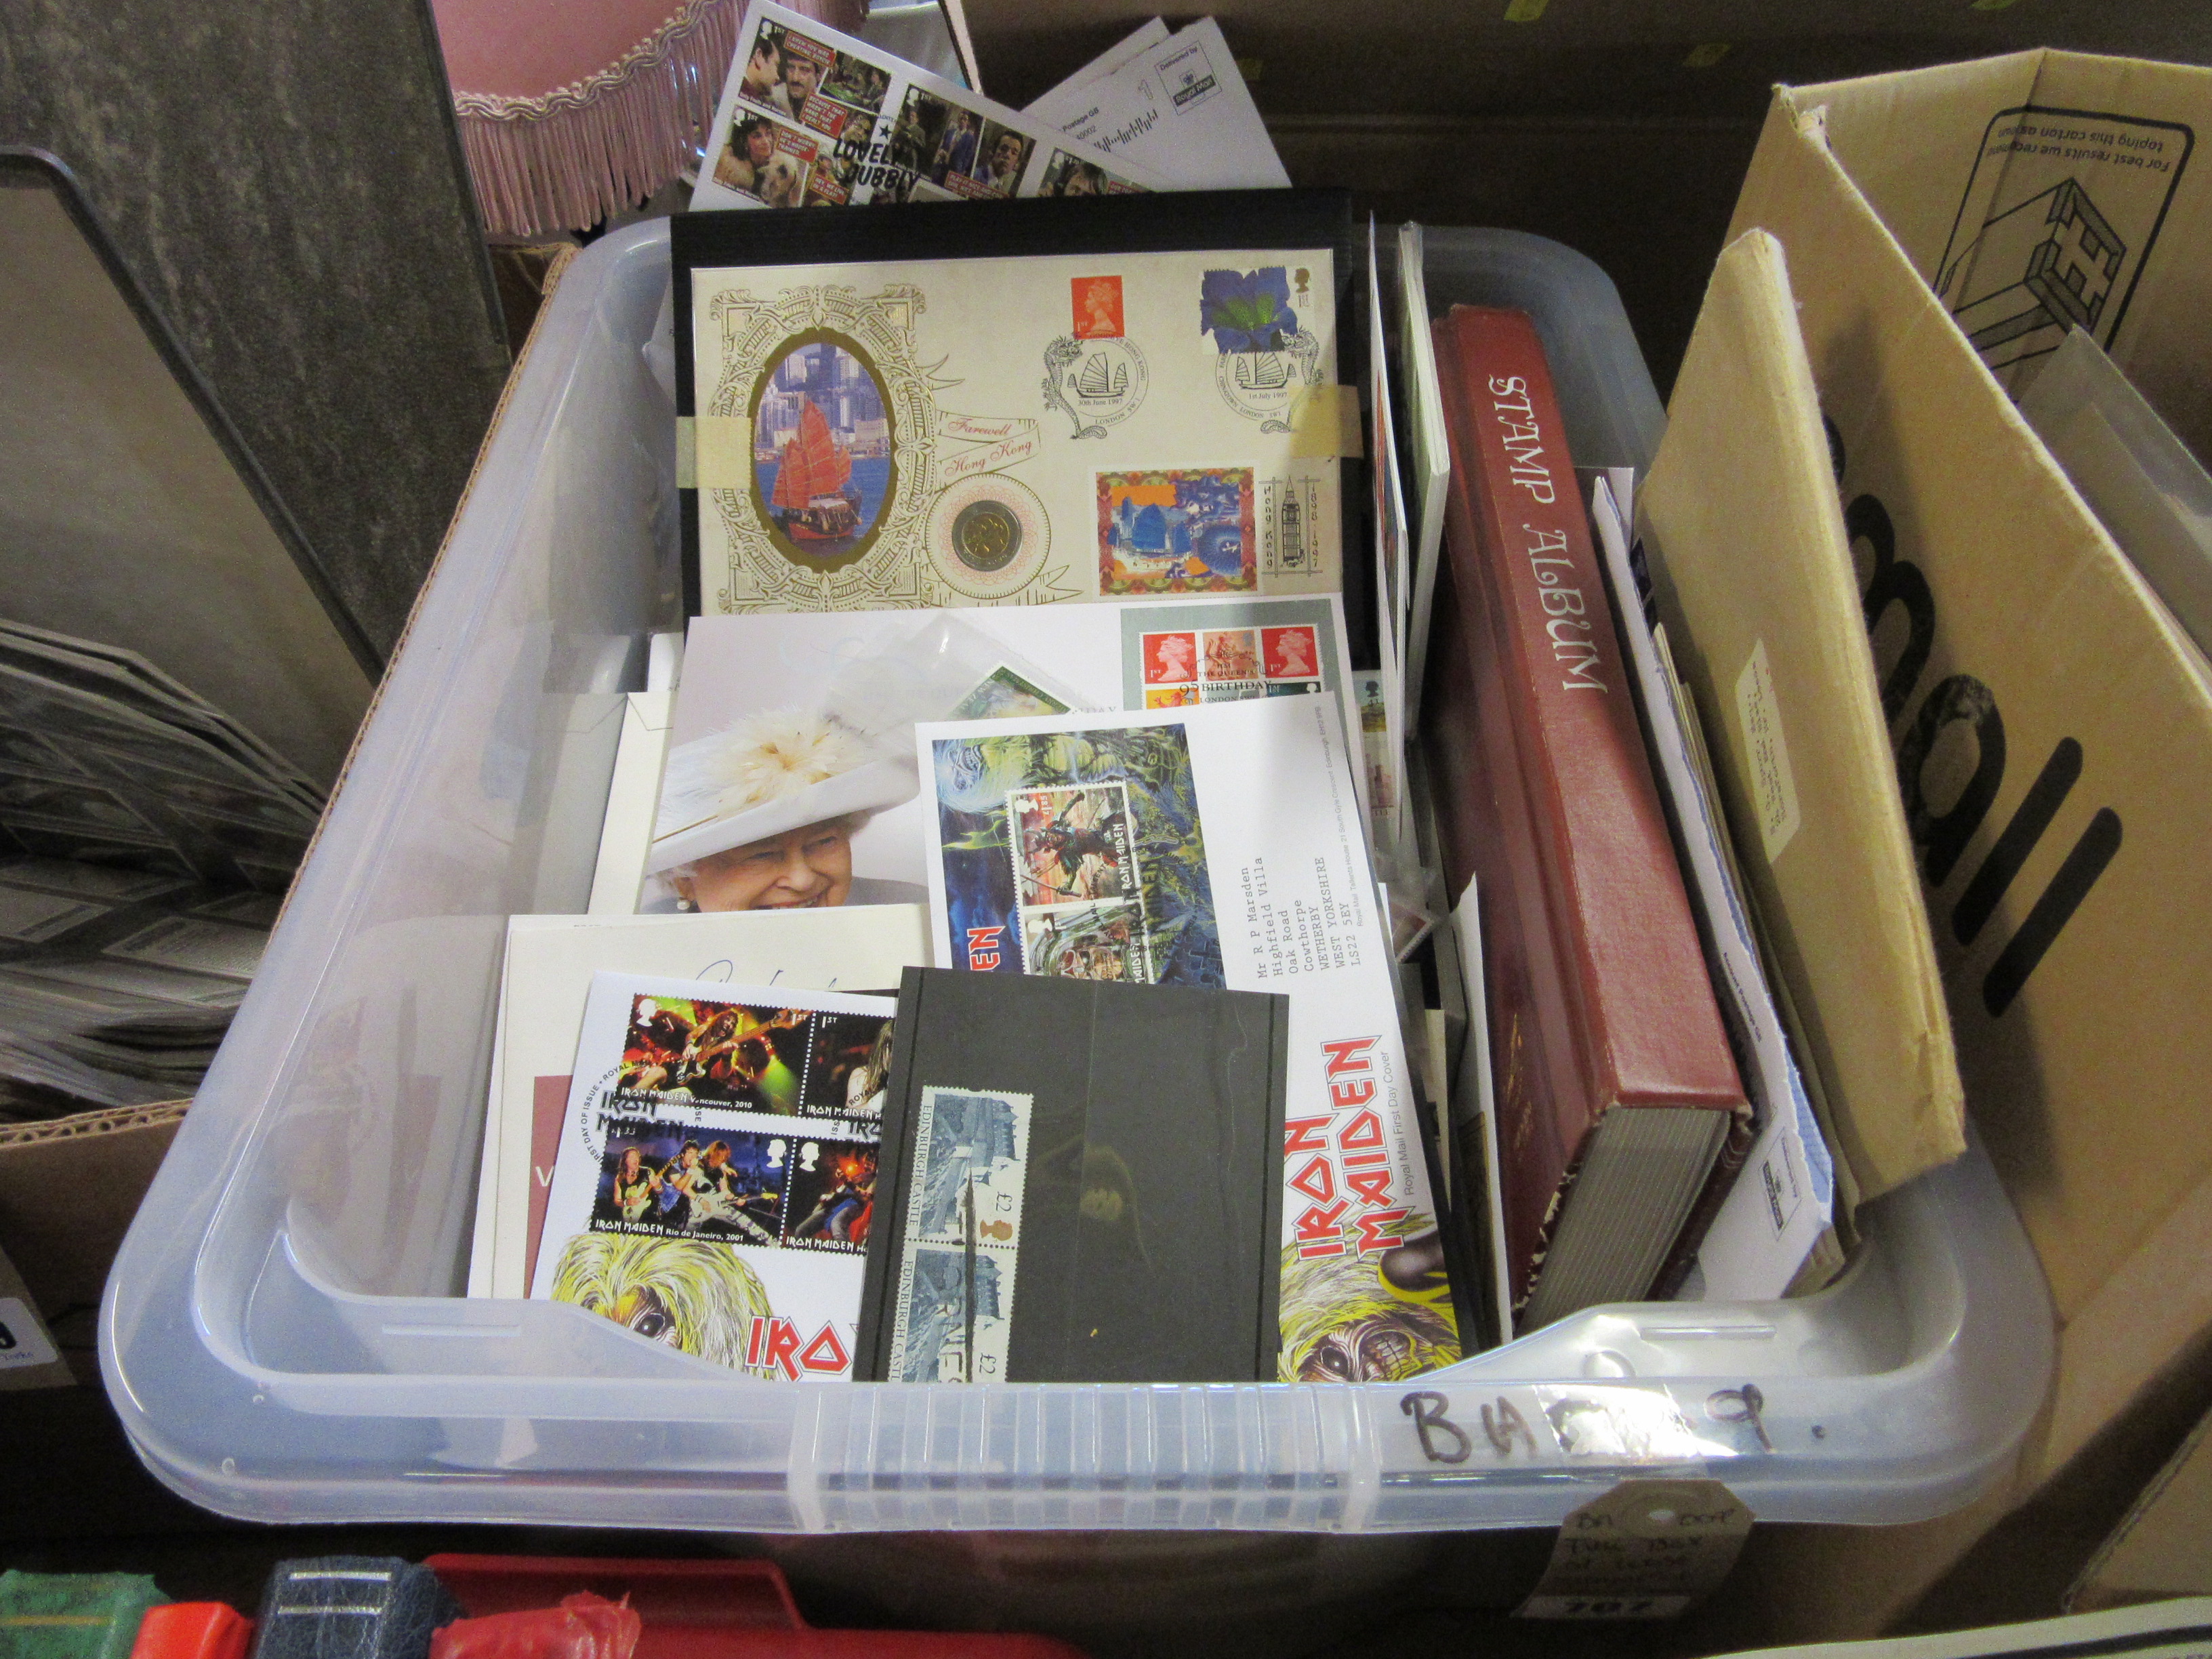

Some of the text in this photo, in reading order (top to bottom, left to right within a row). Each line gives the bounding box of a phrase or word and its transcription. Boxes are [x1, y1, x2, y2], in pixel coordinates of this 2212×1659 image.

[1062, 106, 1100, 132] Postage GB
[2089, 132, 2114, 146] this
[2041, 145, 2061, 155] we
[2065, 148, 2110, 161] results
[2114, 155, 2144, 168] best
[2146, 159, 2171, 171] For
[1124, 342, 1140, 362] HONG
[1137, 360, 1147, 381] KONG
[1219, 375, 1239, 407] CHINATOWN
[1240, 407, 1265, 419] LONDON
[948, 417, 1012, 436] Farewell
[1095, 412, 1126, 425] LONDON
[945, 440, 1032, 477] Hong Kong
[1488, 374, 1609, 693] STAMP ALBUM
[1179, 680, 1200, 699] 95
[1202, 680, 1271, 692] BIRTHDAY
[1200, 695, 1238, 703] LONDON
[1340, 834, 1348, 842] 21
[1344, 844, 1353, 866] House
[1347, 867, 1357, 891] Tallents
[1241, 867, 1257, 922] Marsden
[1351, 893, 1359, 908] Mail
[1254, 857, 1284, 977] Highfield Villa
[1315, 857, 1345, 968] WEST YORKSHIRE
[1278, 909, 1298, 974] Oak Road
[1294, 899, 1315, 971] Cowthorpe
[1308, 906, 1330, 971] WETHERBY
[1339, 903, 1361, 966] LS22 5EY
[1254, 946, 1263, 954] R
[1258, 963, 1268, 979] Mr
[792, 1013, 808, 1025] 1ST
[822, 1016, 838, 1028] 1ST
[603, 1062, 628, 1081] ROYAL
[583, 1085, 600, 1110] ISSUE
[621, 1087, 647, 1099] IRON
[649, 1090, 687, 1103] MAIDEN
[581, 1112, 588, 1125] OF
[807, 1105, 832, 1117] IRON
[834, 1107, 873, 1120] MAIDEN
[1381, 1052, 1414, 1195] Royal Mail First Day Cover
[581, 1128, 591, 1145] DAY
[1321, 1036, 1416, 1261] MAIDEN
[908, 1105, 933, 1226] EDINBURGH CASTLE
[996, 1191, 1012, 1212] £2
[595, 1219, 744, 1242] IRON MAIDEN Rio de Janeiro, 2001
[785, 1236, 854, 1252] IRON MAIDEN
[895, 1261, 913, 1338] EDINBURGH
[979, 1352, 996, 1374] £2
